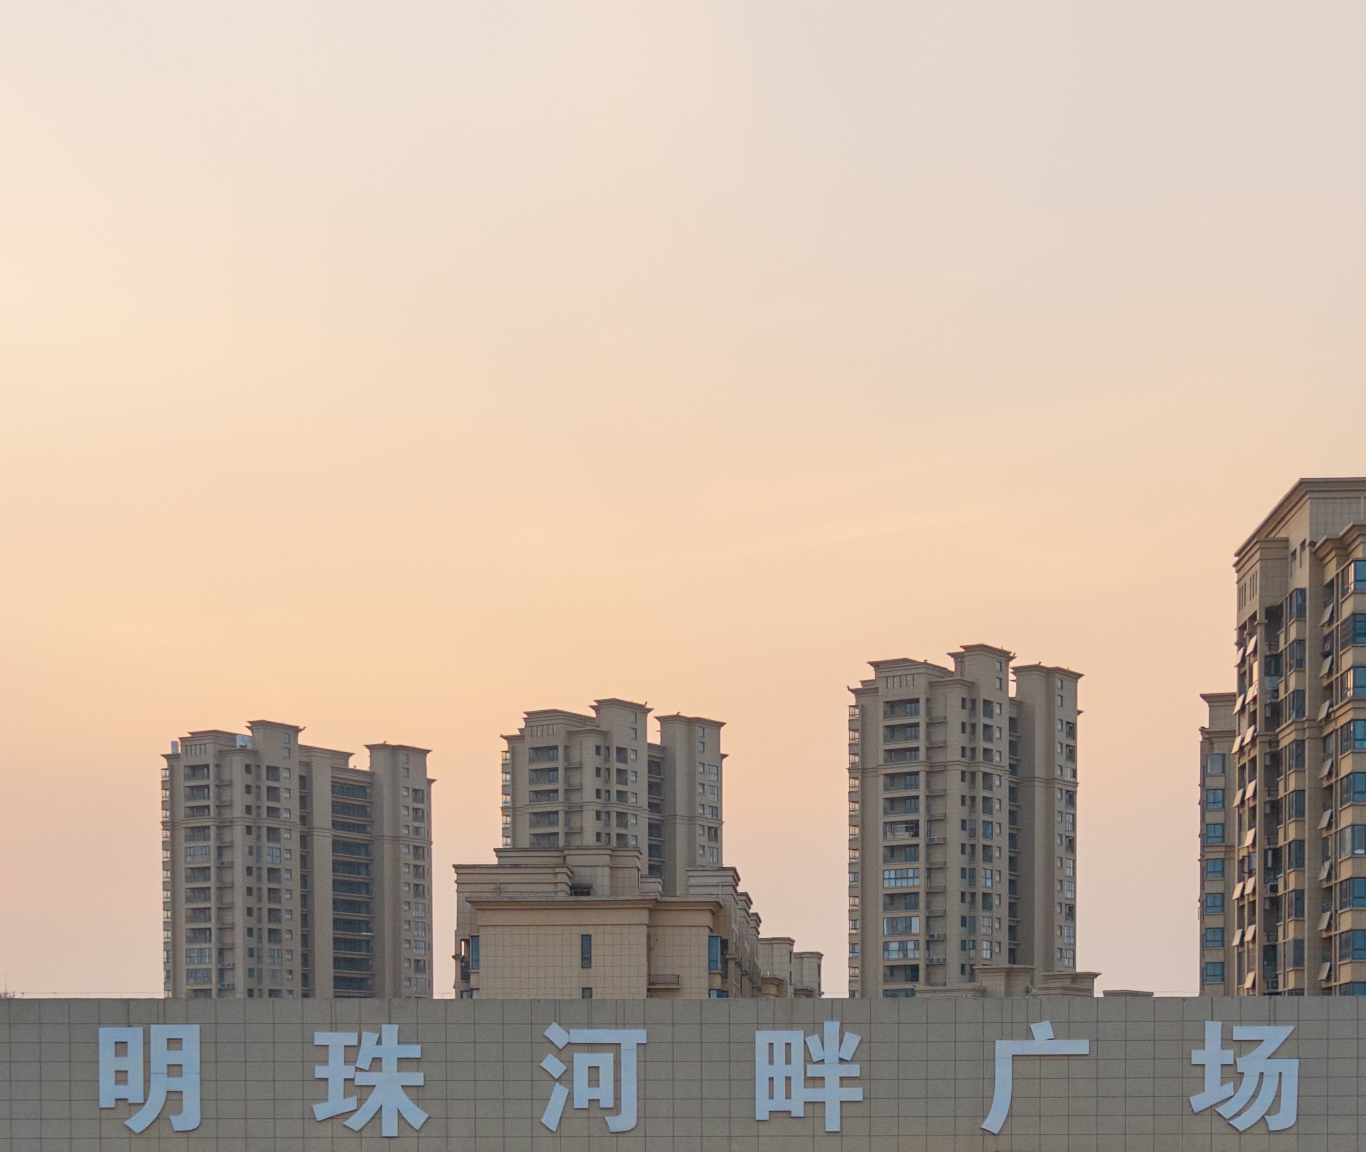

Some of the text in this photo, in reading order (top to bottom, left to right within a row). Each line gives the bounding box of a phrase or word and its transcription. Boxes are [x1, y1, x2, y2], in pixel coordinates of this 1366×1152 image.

[97, 1020, 1300, 1138] 明珠河畔广场
